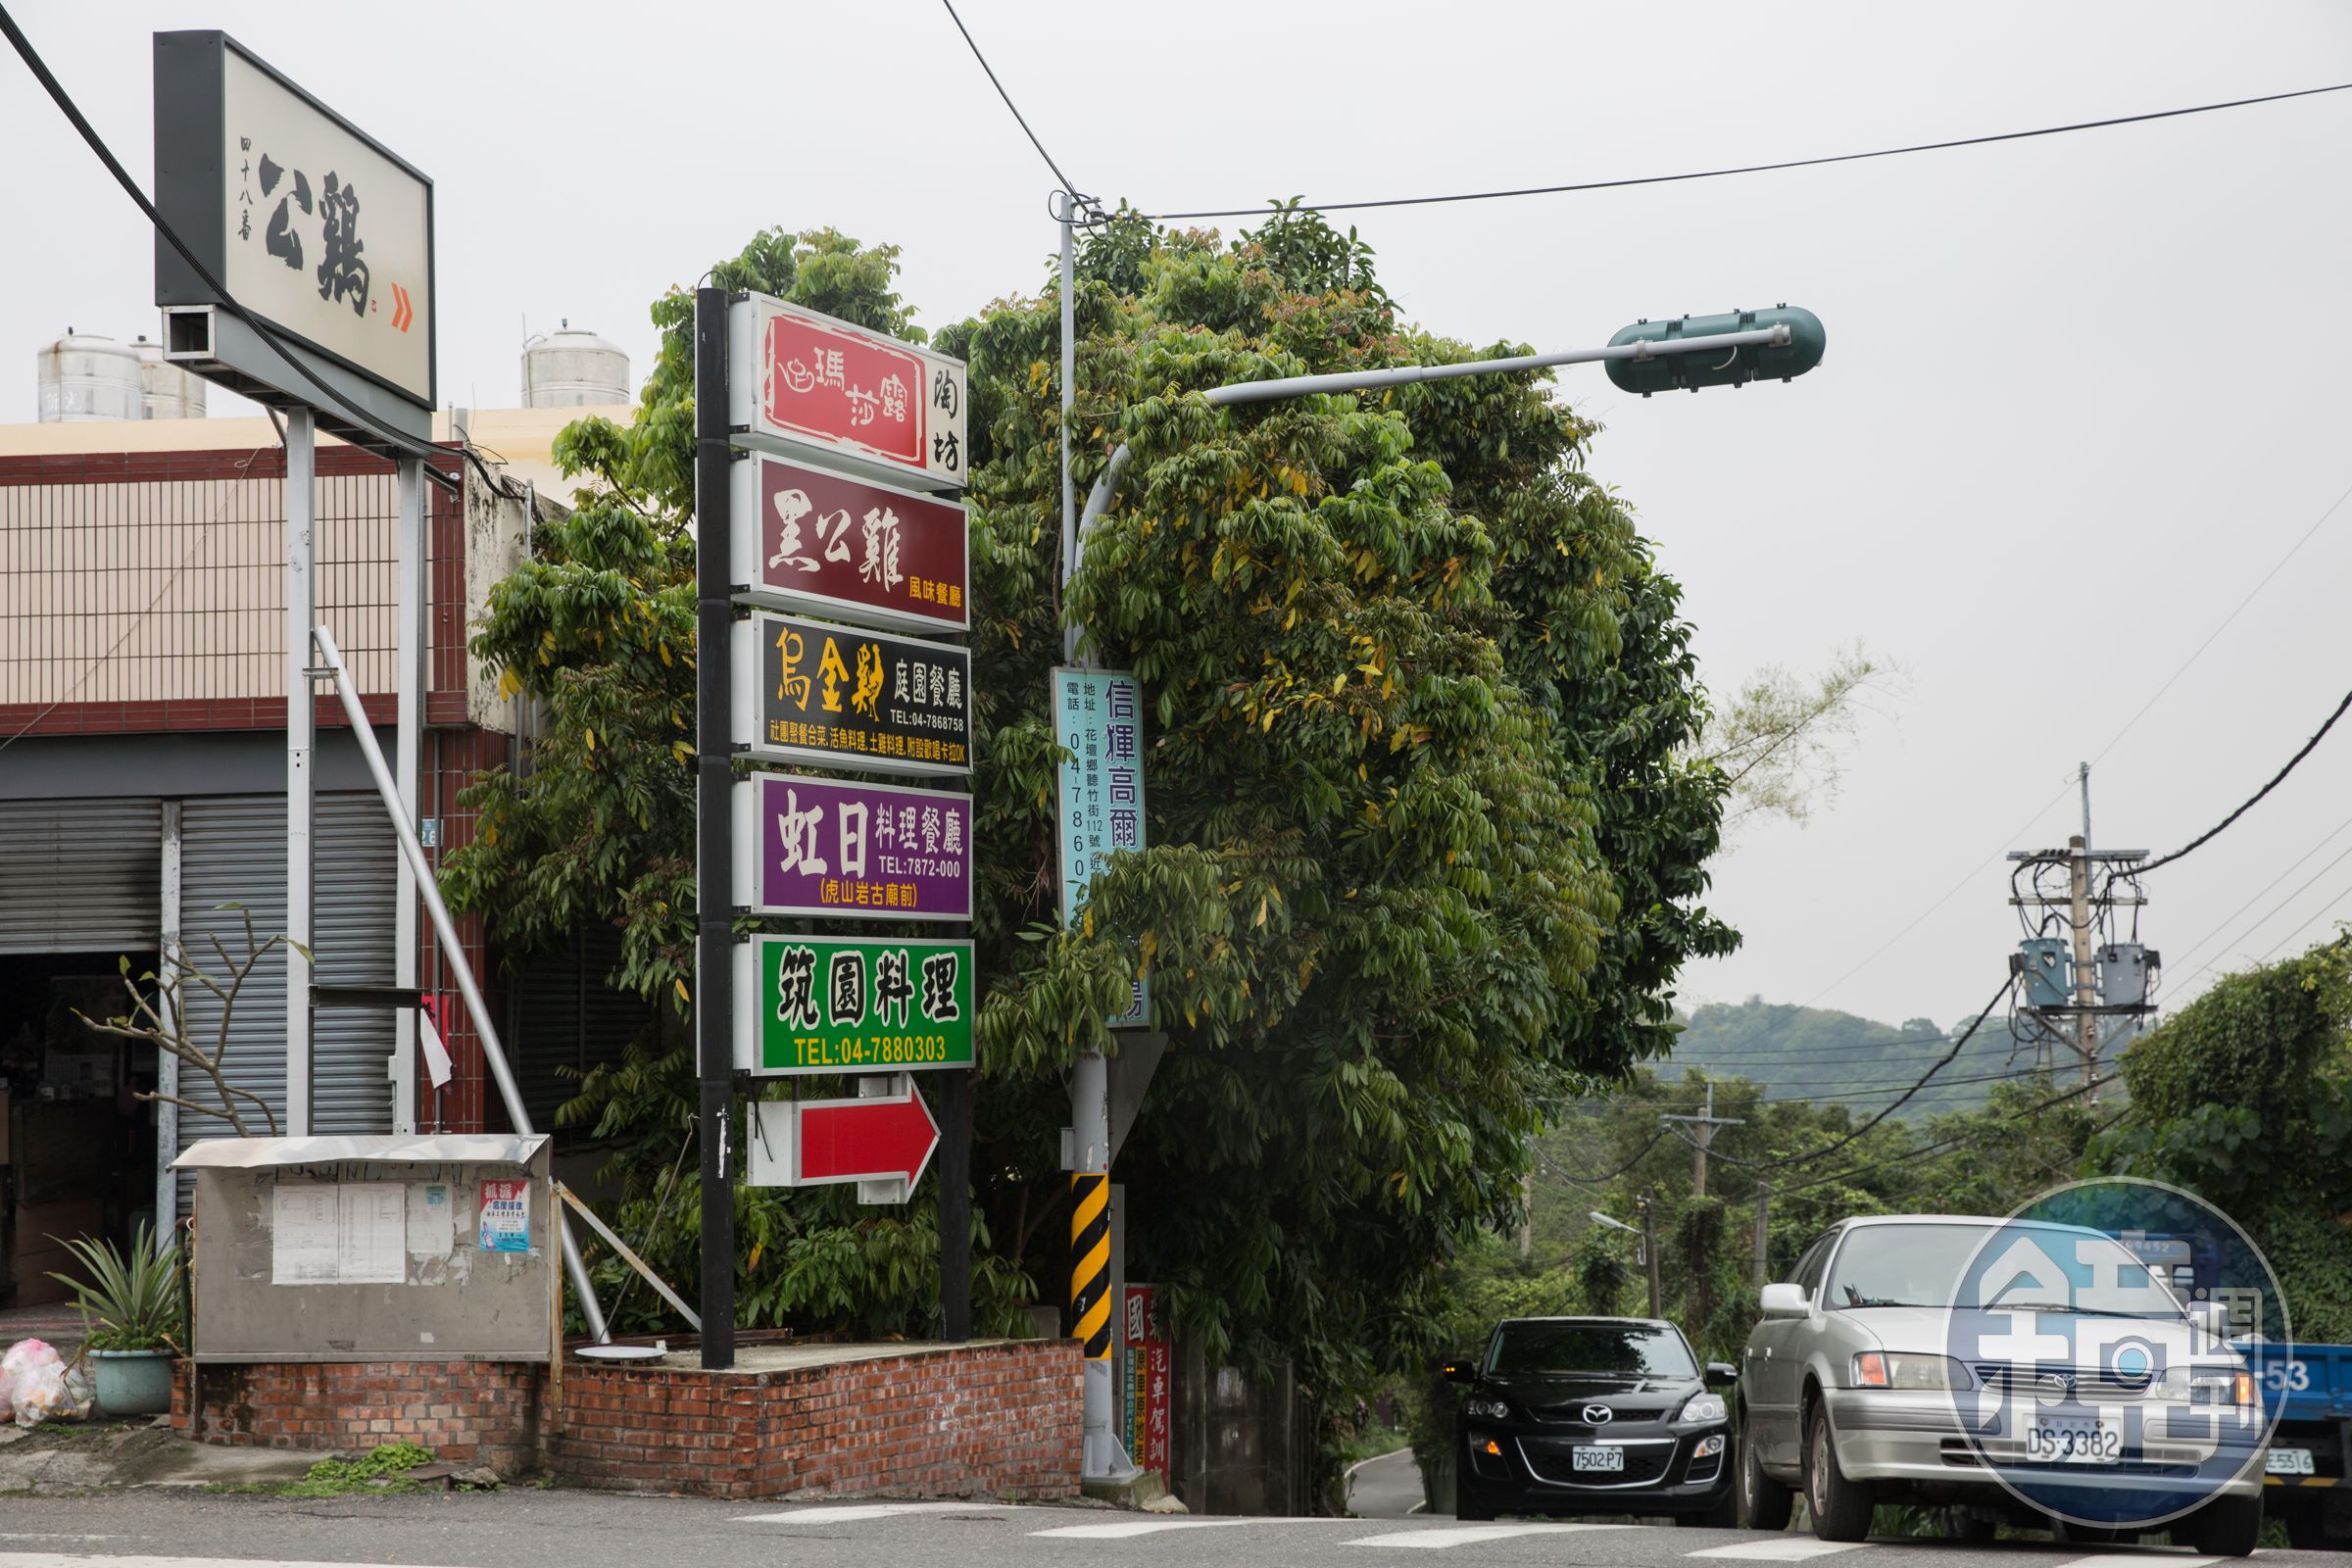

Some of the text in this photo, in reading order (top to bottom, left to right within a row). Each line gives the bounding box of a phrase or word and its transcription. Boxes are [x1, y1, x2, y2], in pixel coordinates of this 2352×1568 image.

[813, 346, 908, 426] 瑪莎露
[933, 368, 959, 472] 陶坊
[908, 575, 962, 609] 風味餐廳
[893, 657, 964, 710] 庭園餐廳
[890, 708, 964, 733] TEL:04-7868758
[1102, 680, 1137, 871] 信輝高爾
[777, 788, 868, 879] 虹日
[875, 801, 964, 857] 料理餐廳
[820, 877, 918, 909] (虎山岩古廟前)
[878, 855, 961, 878] TEL:7872-000
[777, 945, 960, 1032] 筑園料理
[794, 1035, 947, 1066] TEL:04-7880303
